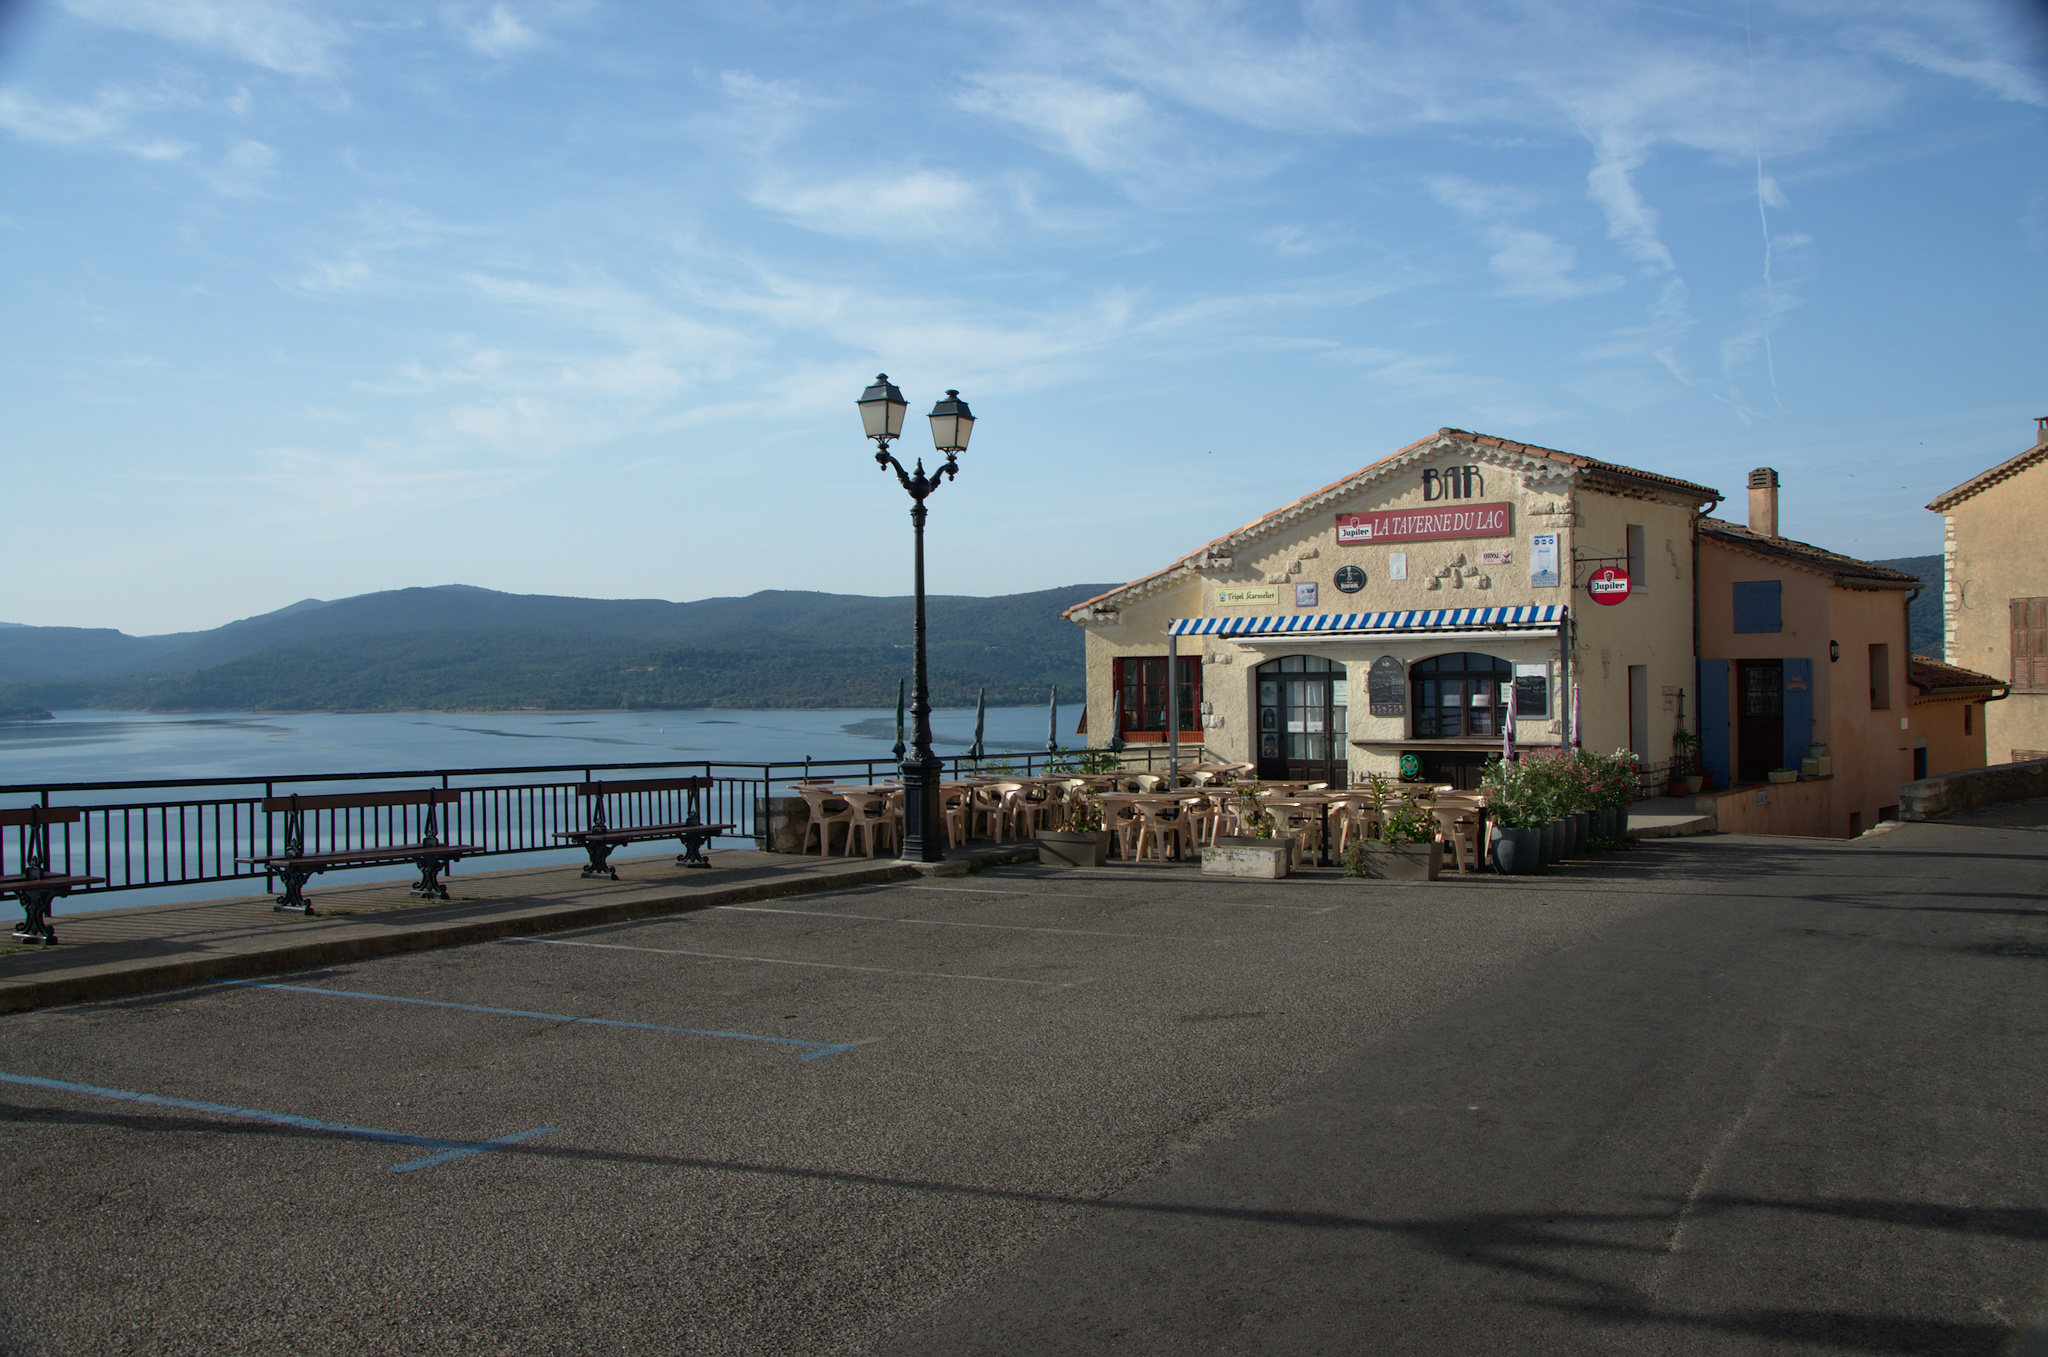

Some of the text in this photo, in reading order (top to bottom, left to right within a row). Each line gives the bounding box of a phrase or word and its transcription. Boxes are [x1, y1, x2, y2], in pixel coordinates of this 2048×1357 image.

[1421, 465, 1484, 501] BAR
[1373, 510, 1504, 536] LA TAVERNE DU LAC
[1342, 528, 1370, 538] Jupiler
[1594, 581, 1626, 592] Jupiler
[1228, 592, 1244, 602] Tripel
